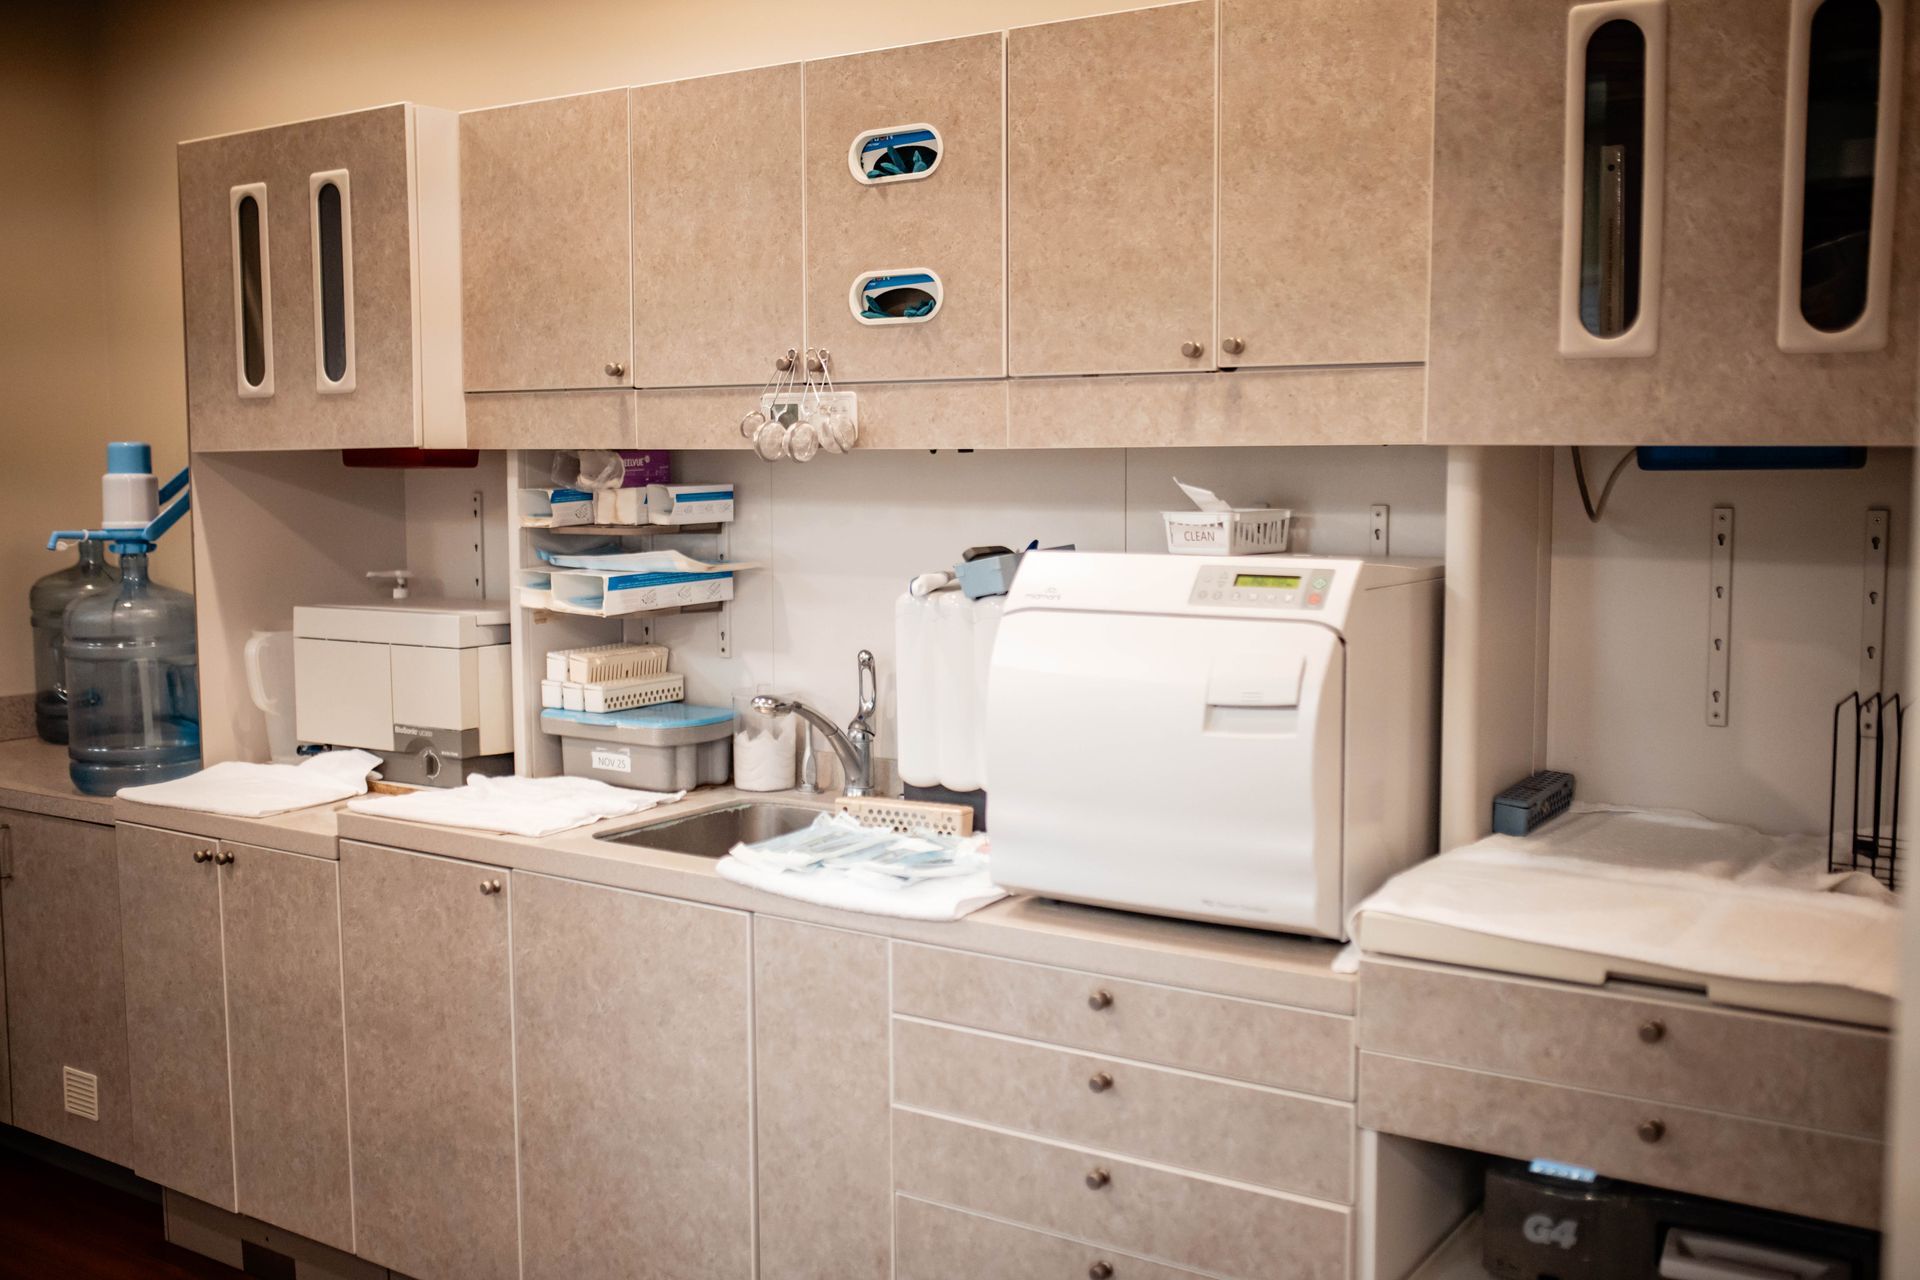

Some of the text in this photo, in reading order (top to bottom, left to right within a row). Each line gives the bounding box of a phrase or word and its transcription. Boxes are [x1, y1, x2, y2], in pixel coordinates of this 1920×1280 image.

[623, 458, 644, 467] EELVUE
[1184, 530, 1215, 542] CLEAN
[598, 756, 615, 767] NOV
[1523, 1214, 1578, 1249] G4
